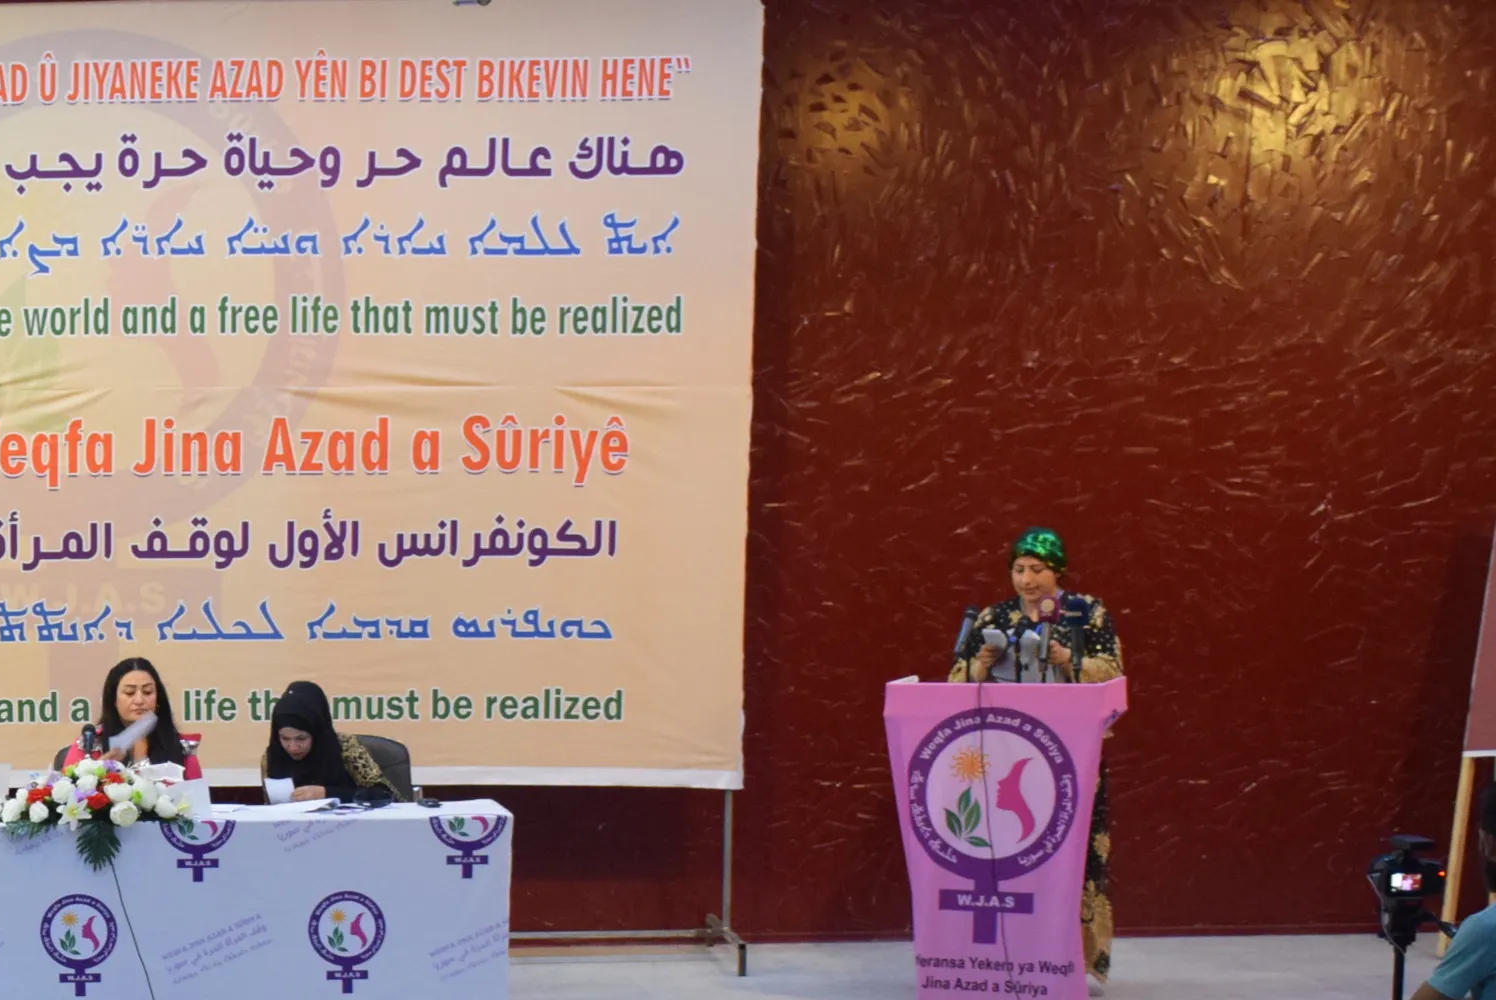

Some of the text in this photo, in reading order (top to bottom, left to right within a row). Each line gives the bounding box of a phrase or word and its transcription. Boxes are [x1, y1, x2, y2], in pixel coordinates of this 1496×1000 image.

[40, 53, 56, 103] Û
[69, 61, 197, 100] JIYANEKE
[210, 61, 282, 97] AZAD
[296, 50, 348, 100] YÊN
[360, 60, 386, 97] BI
[400, 60, 466, 98] DEST
[479, 60, 587, 97] BIKEVIN
[6, 154, 101, 193] يجب
[119, 135, 206, 188] حرة
[225, 134, 339, 188] وحياة
[357, 149, 421, 187] حر
[440, 138, 551, 187] عالم
[570, 137, 683, 179] هناك
[26, 299, 109, 335] world
[123, 298, 175, 333] and
[192, 308, 204, 332] a
[220, 297, 277, 332] free
[293, 297, 337, 330] life
[353, 300, 410, 331] that
[427, 303, 496, 333] must
[513, 299, 544, 333] be
[562, 298, 681, 332] realized
[134, 419, 240, 473] Jina
[264, 418, 388, 471] Azad
[413, 431, 439, 470] a
[462, 416, 628, 483] Sûriyê
[132, 519, 248, 568] لوقف
[270, 512, 358, 568] الأول
[379, 519, 615, 567] الكونفرانس
[71, 702, 91, 722] a
[183, 690, 237, 721] life
[332, 692, 418, 720] must
[433, 690, 473, 720] be
[485, 689, 624, 720] realized
[953, 715, 981, 731] Jina
[986, 713, 1021, 728] Azad
[1022, 722, 1032, 732] a
[957, 893, 1015, 908] W.J.A.S
[921, 976, 950, 990] Jina
[953, 977, 988, 992] Azad
[991, 982, 1000, 993] a
[968, 956, 1014, 972] Yekem
[1018, 962, 1035, 975] ya
